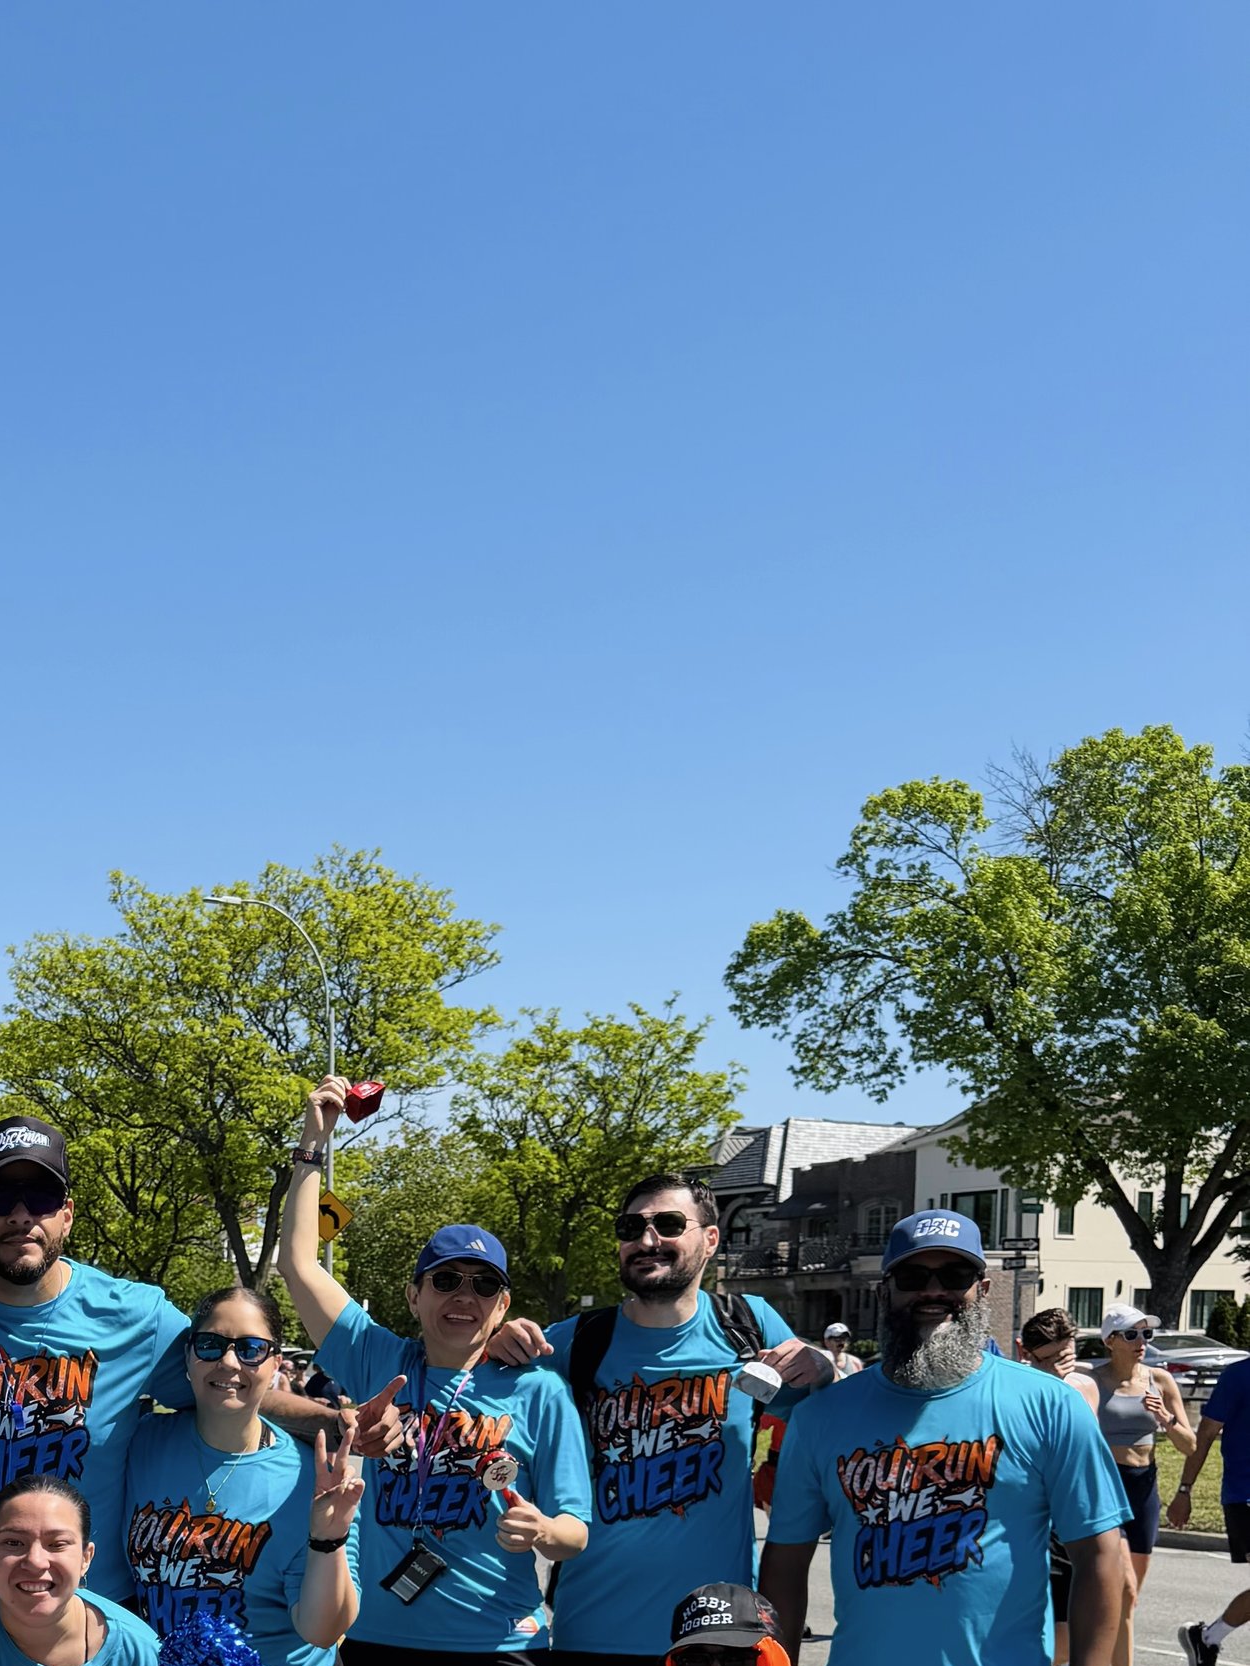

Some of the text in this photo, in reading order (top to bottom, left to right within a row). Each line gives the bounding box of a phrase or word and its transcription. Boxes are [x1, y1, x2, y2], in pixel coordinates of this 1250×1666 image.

[14, 1348, 95, 1407] RUN
[587, 1372, 729, 1446] YOU RUN
[631, 1420, 675, 1459] WE
[598, 1441, 724, 1522] CHEER
[837, 1434, 999, 1512] YOU RUN
[888, 1486, 936, 1522] WE
[129, 1502, 271, 1569] YOU RUN
[855, 1510, 987, 1587] CHEER
[159, 1554, 201, 1587] WE
[678, 1613, 734, 1635] JOGGER
[682, 1596, 732, 1621] HOBBY
